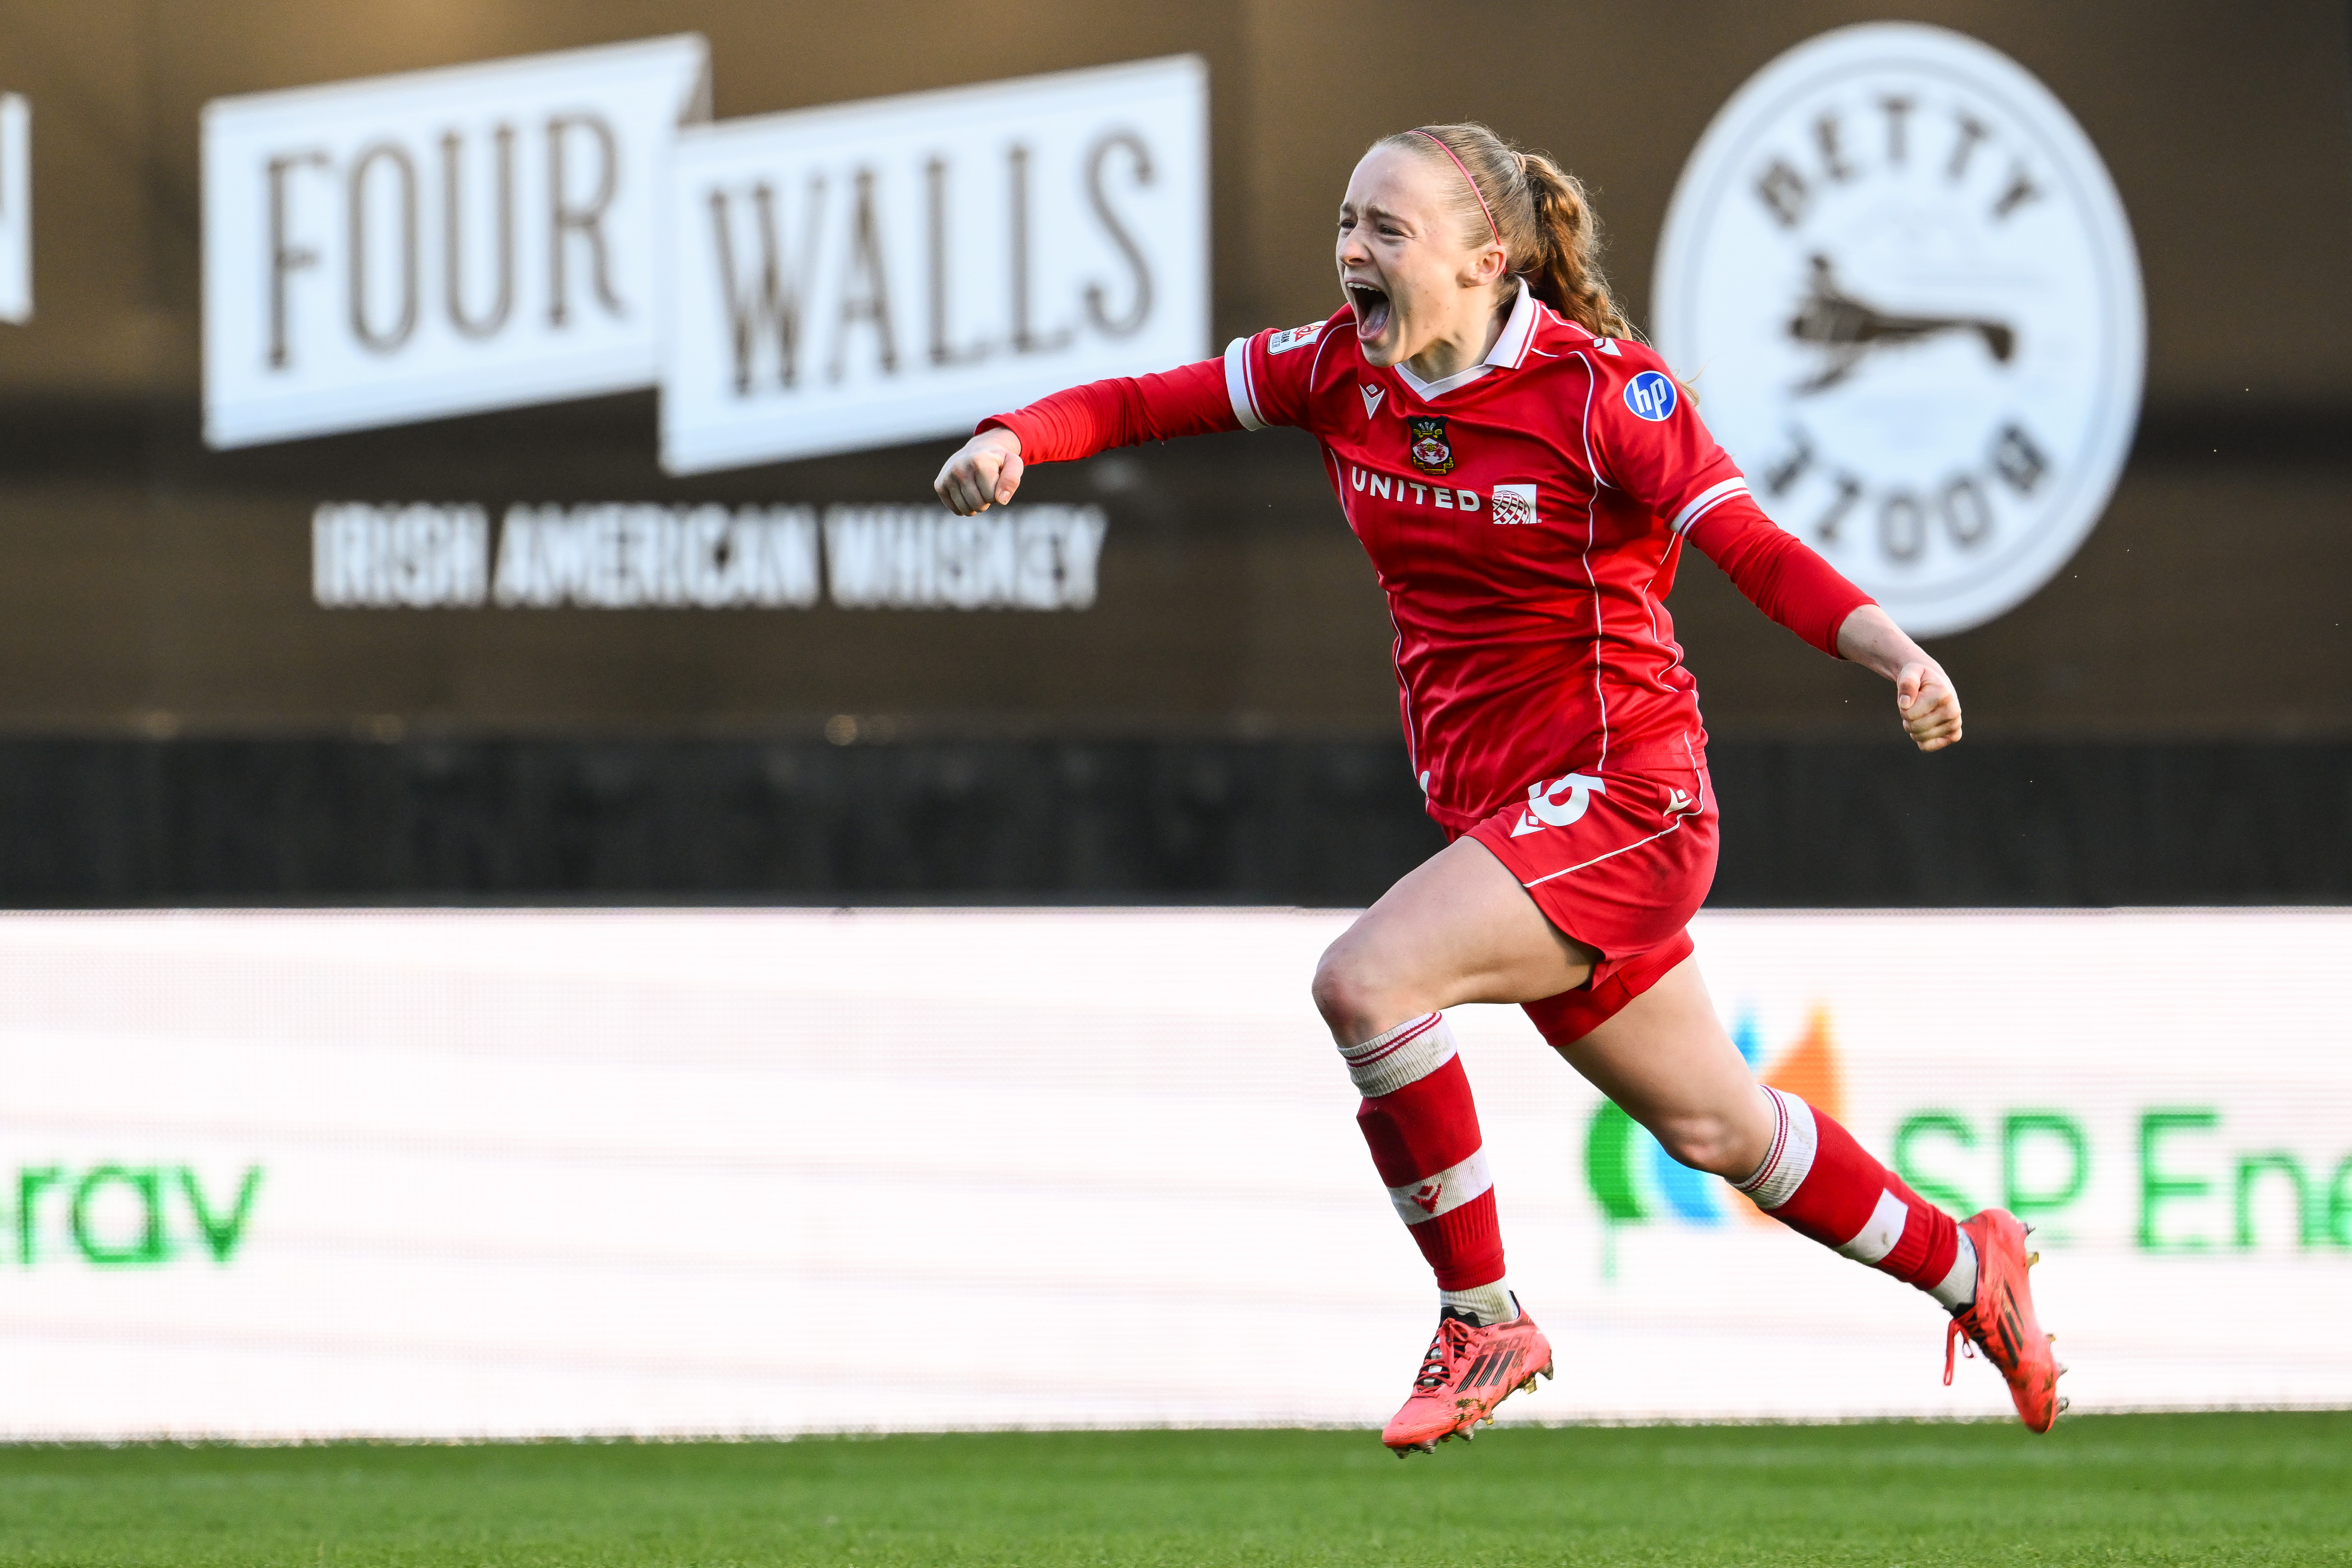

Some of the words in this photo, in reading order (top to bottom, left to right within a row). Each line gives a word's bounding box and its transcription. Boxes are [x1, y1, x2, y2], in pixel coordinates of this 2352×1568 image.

[1752, 94, 2042, 229] BETTY
[263, 109, 630, 373] FOUR
[707, 129, 1156, 396] WALLS
[1631, 377, 1668, 420] hp
[311, 502, 489, 610] IRISH
[492, 502, 820, 610] AMERICAN
[824, 503, 1107, 611] WHISKEY
[1351, 466, 1481, 512] UNITED
[1761, 426, 2049, 563] BOOZE
[1891, 1107, 2089, 1218] SP
[2133, 1106, 2352, 1254] En
